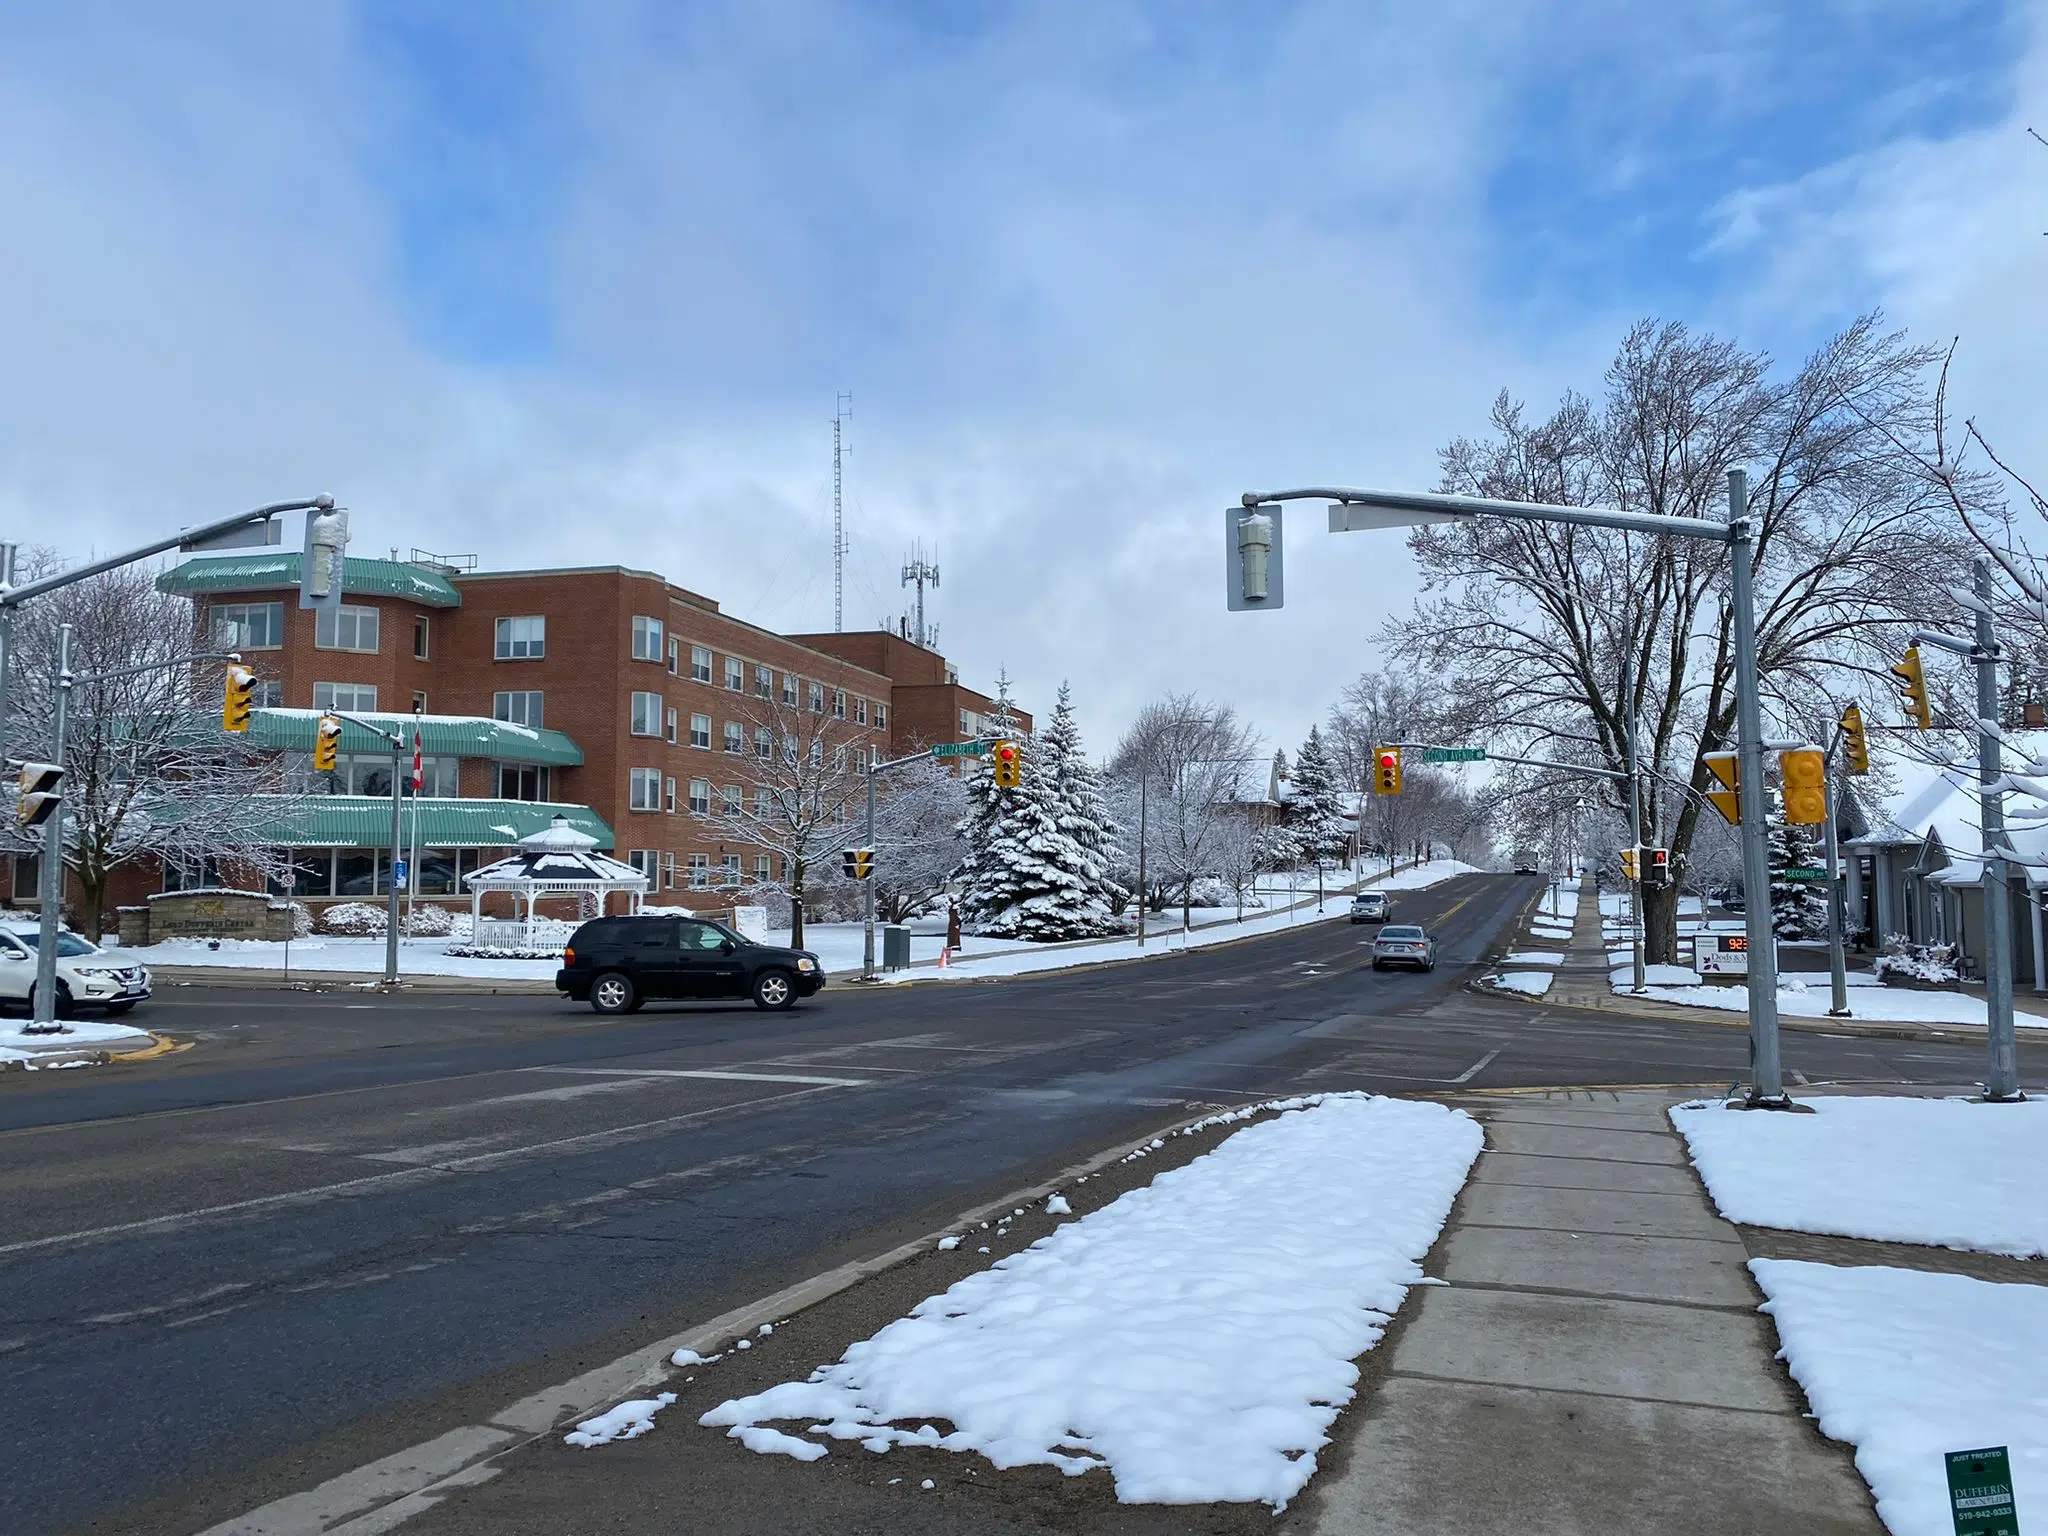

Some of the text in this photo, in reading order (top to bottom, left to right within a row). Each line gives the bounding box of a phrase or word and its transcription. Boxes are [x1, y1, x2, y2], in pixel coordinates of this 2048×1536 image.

[1423, 750, 1475, 762] SECOND AVENUE
[1786, 870, 1815, 878] SECOND
[1711, 952, 1733, 961] Dods
[1952, 1450, 2002, 1462] JUST TREATED
[1954, 1484, 2010, 1498] DUFFERIN
